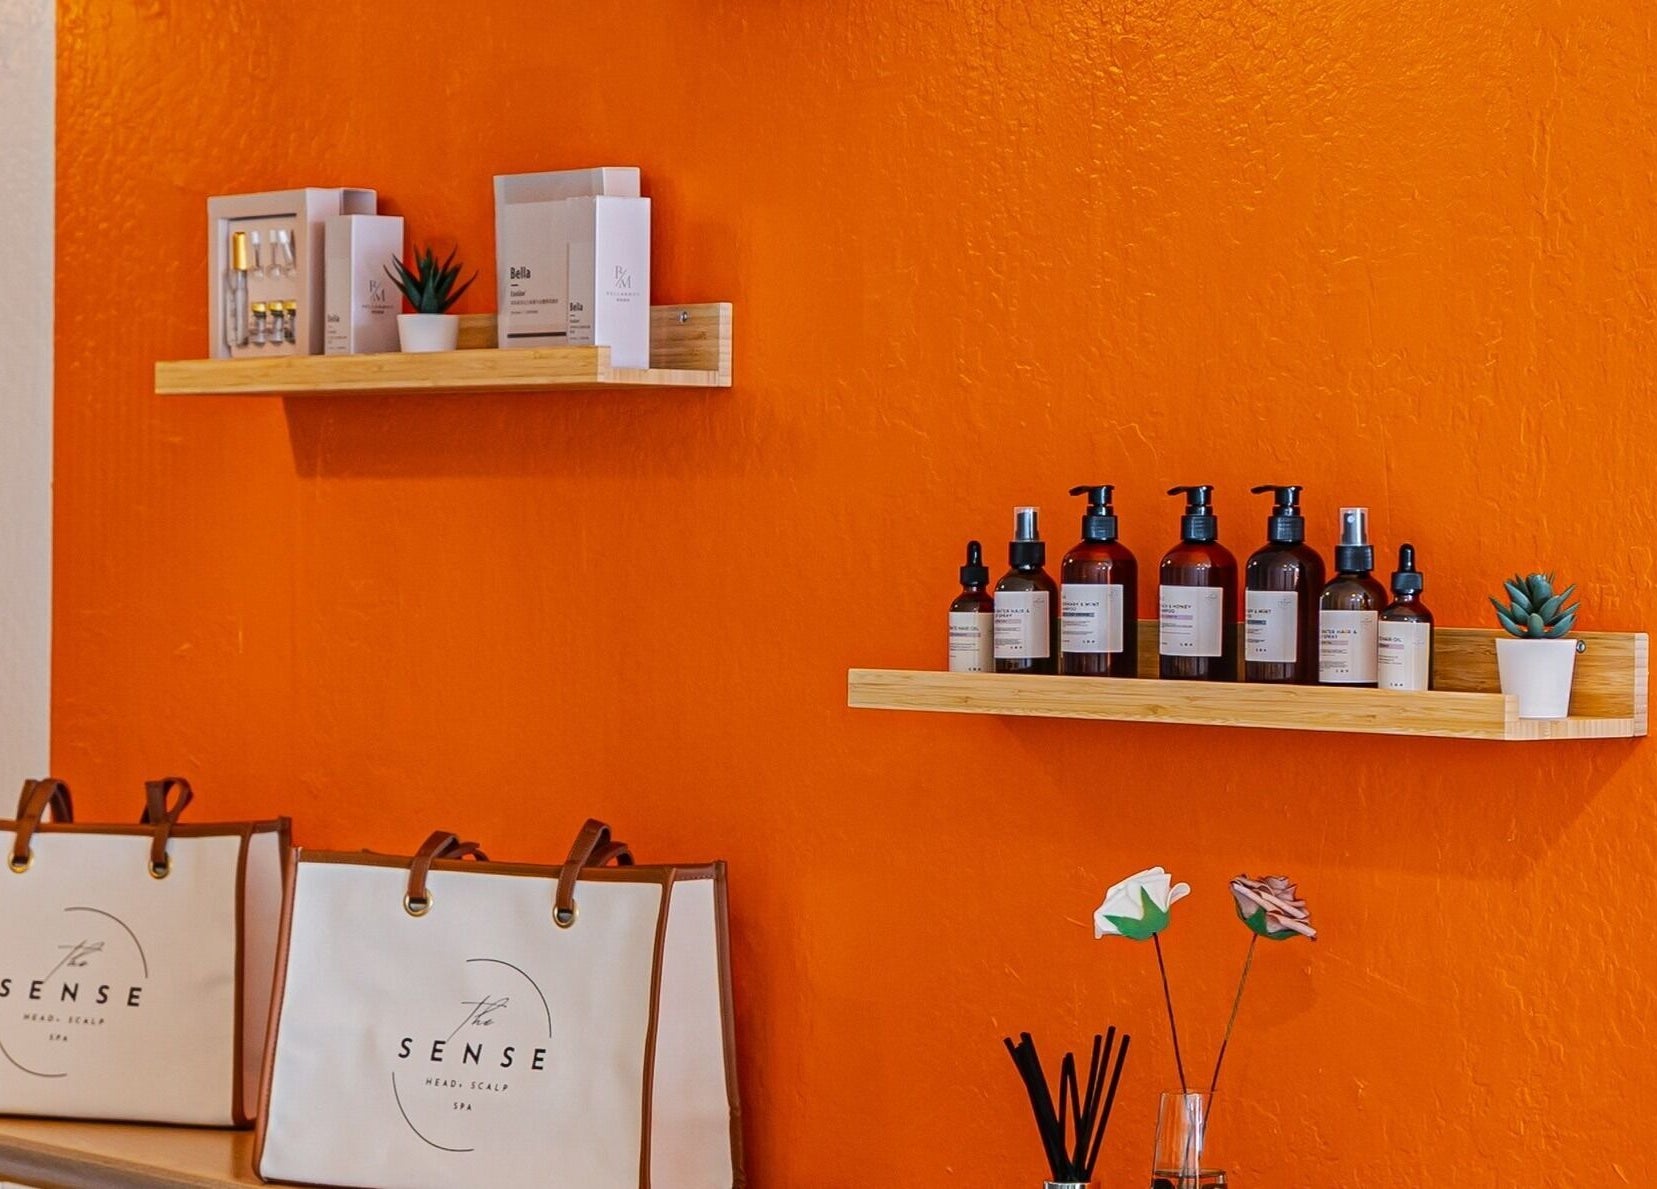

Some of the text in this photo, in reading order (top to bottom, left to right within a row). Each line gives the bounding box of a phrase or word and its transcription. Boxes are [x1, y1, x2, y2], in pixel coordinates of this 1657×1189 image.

[510, 266, 531, 280] Bella
[0, 978, 143, 1007] SENSE
[68, 1015, 105, 1025] SCALP
[49, 1033, 68, 1042] SPA
[398, 1037, 547, 1071] SENSE
[470, 1081, 509, 1092] SCALP
[453, 1102, 472, 1111] SPA
